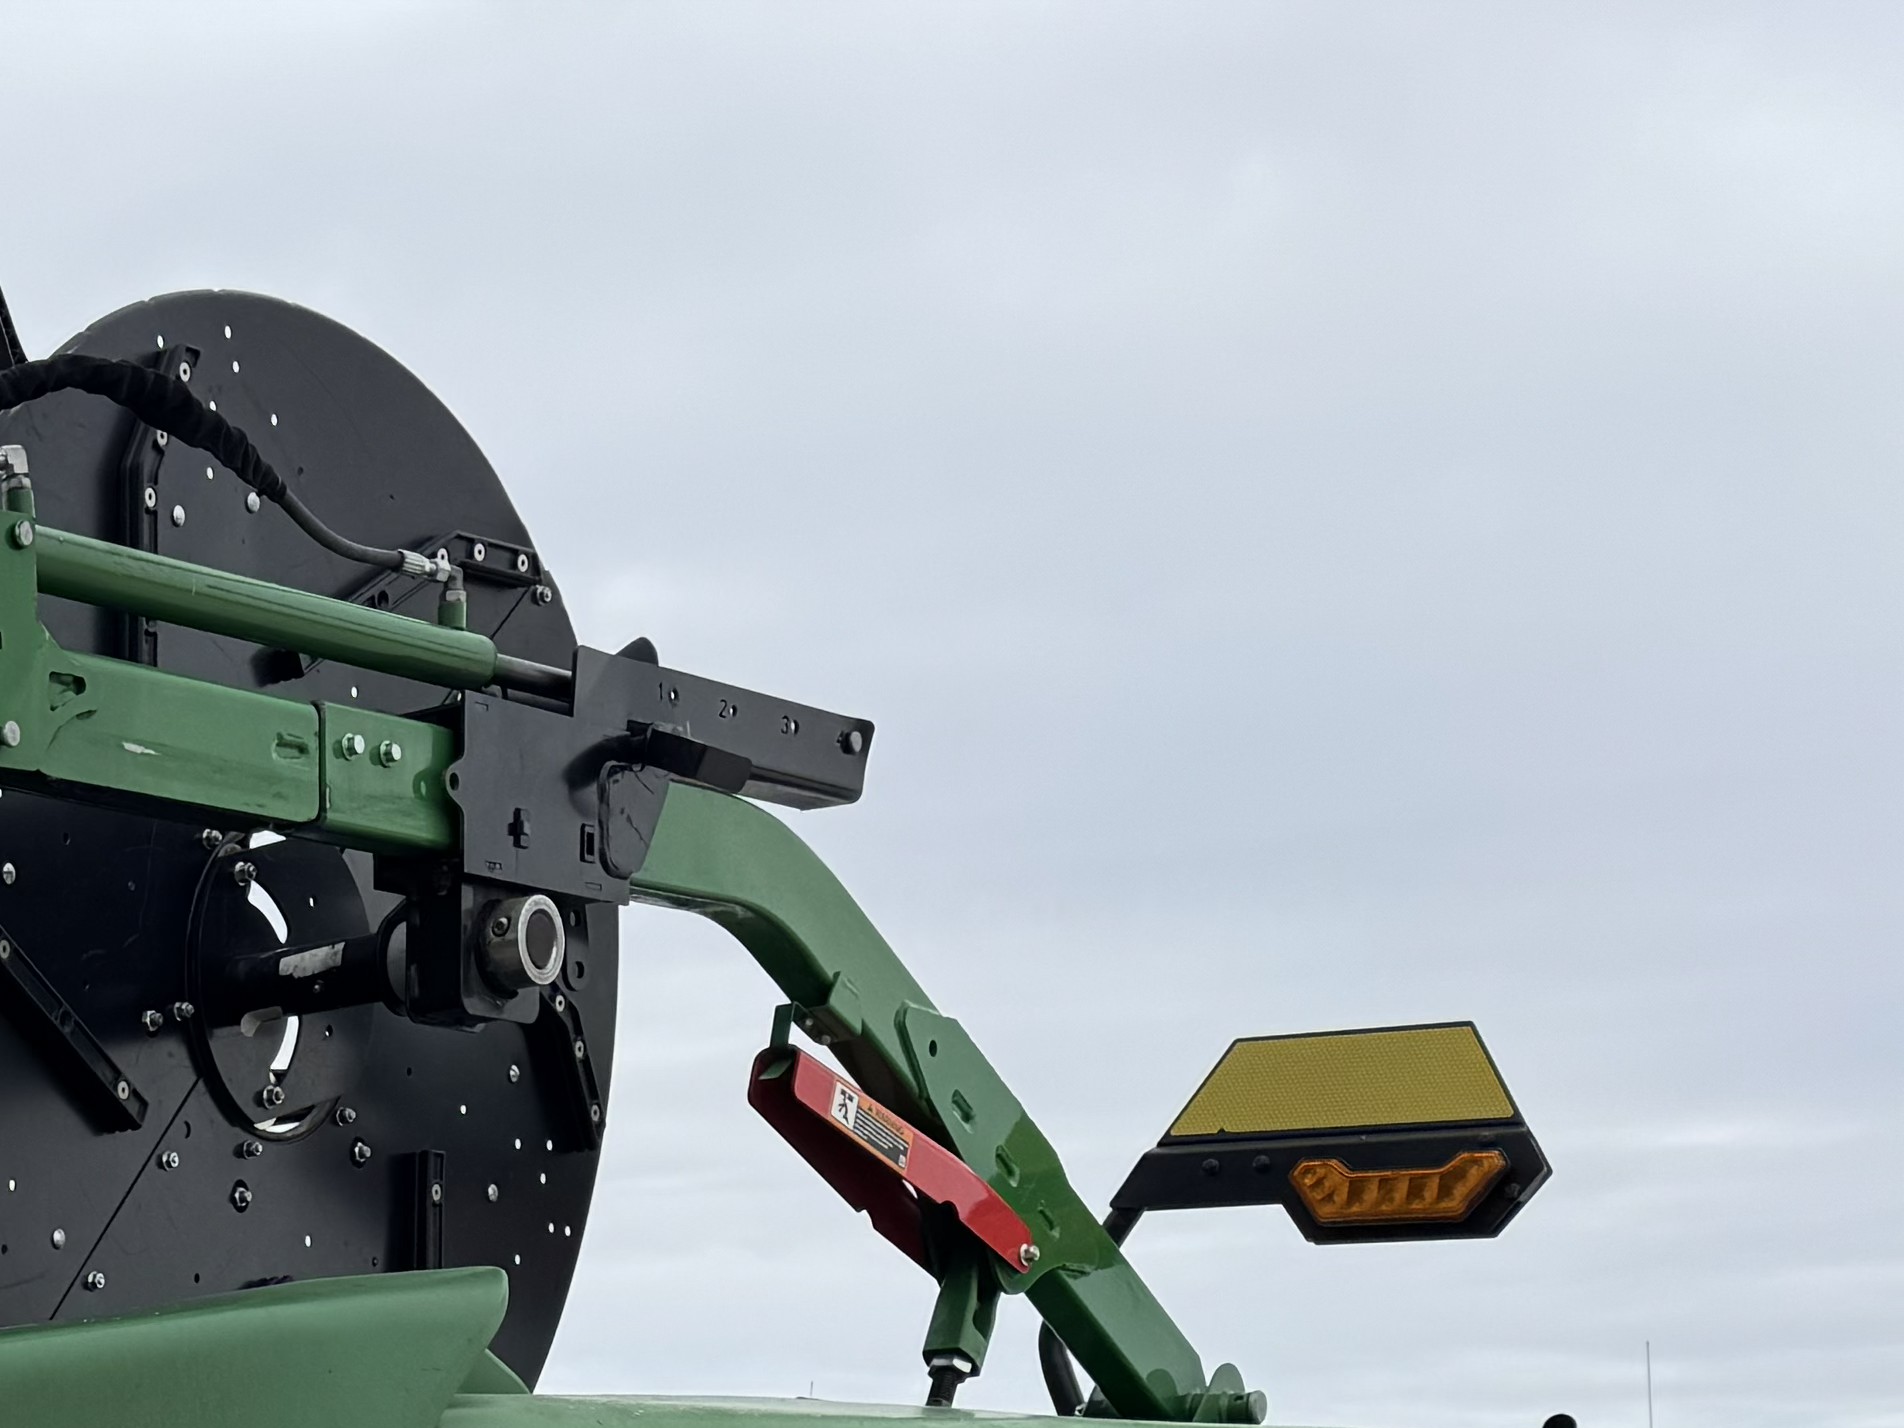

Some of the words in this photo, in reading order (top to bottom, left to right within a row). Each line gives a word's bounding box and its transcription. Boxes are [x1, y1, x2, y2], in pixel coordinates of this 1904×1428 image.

[657, 681, 664, 701] 1
[717, 698, 728, 719] 2
[779, 715, 791, 735] 3
